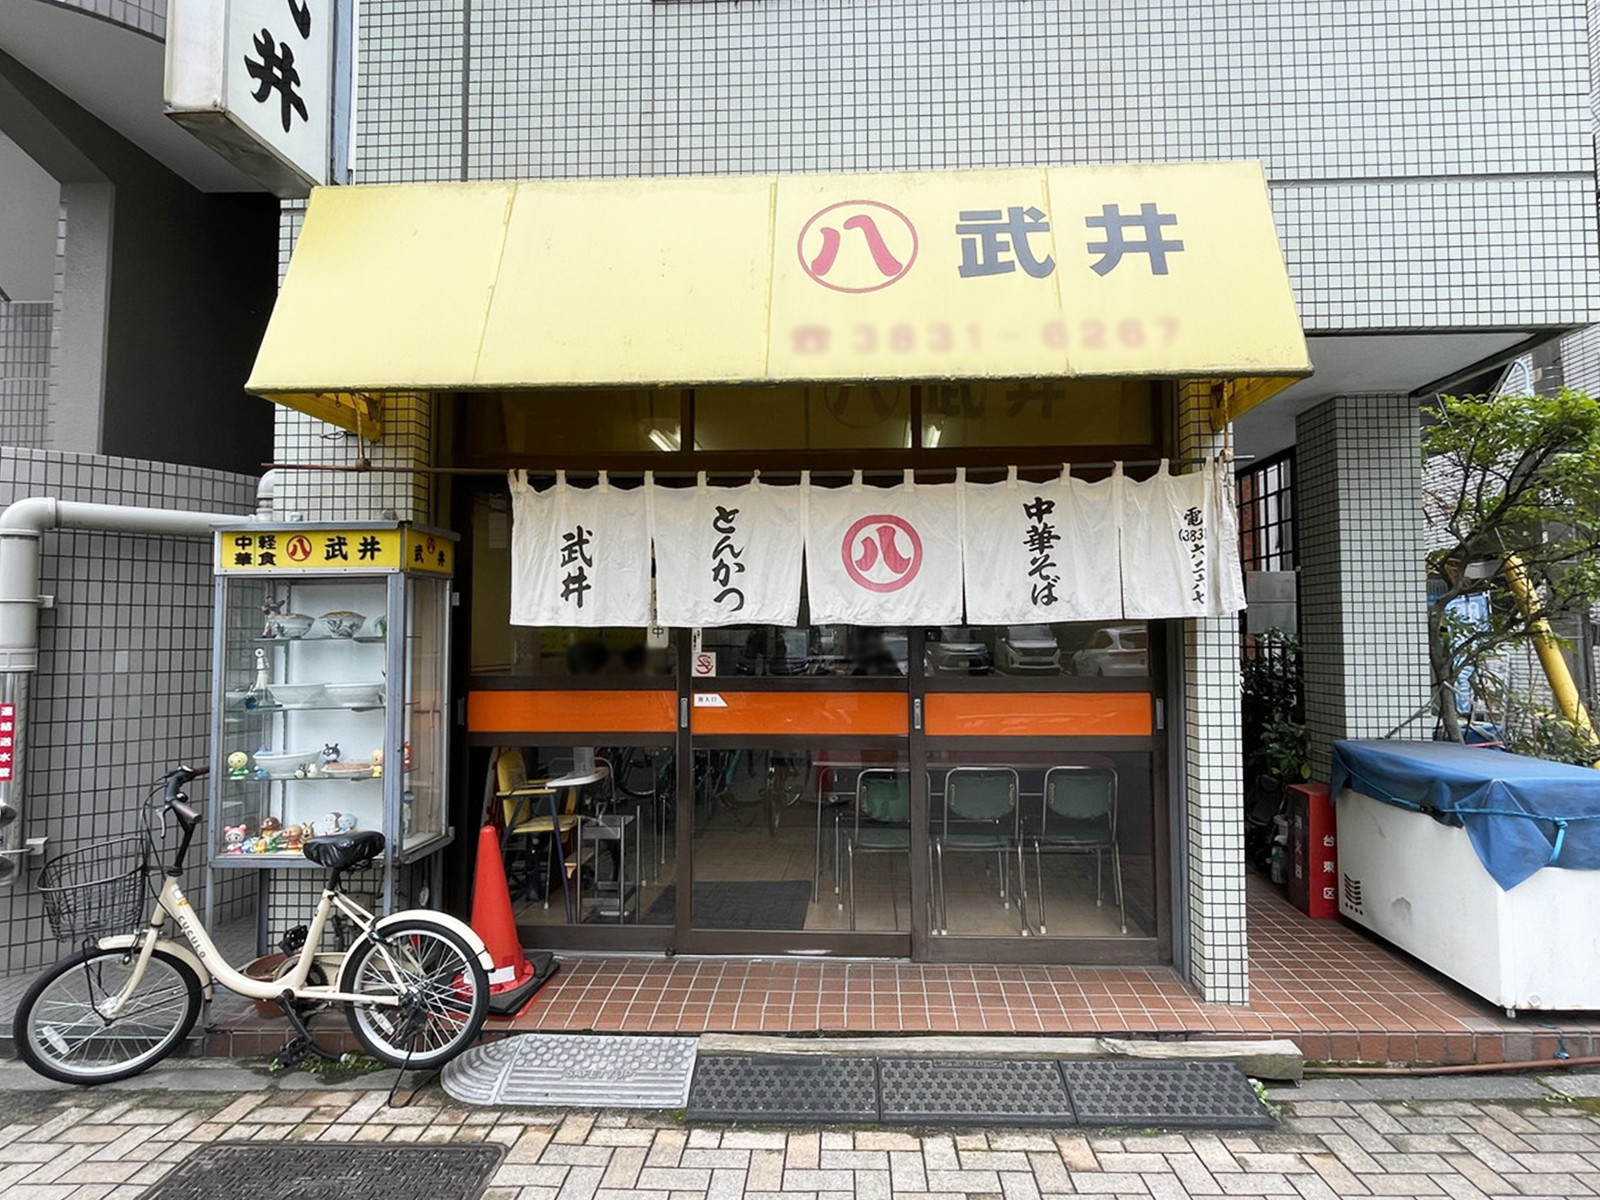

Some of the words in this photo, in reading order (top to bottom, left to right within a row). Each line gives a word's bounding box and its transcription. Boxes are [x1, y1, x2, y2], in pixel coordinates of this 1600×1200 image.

[244, 0, 311, 133] 井
[956, 203, 1184, 278] 武井
[324, 536, 382, 561] 武井
[560, 525, 593, 608] 武井
[712, 505, 745, 612] とんかつ
[1023, 496, 1061, 606] 中華そば
[1323, 834, 1335, 899] 台東区
